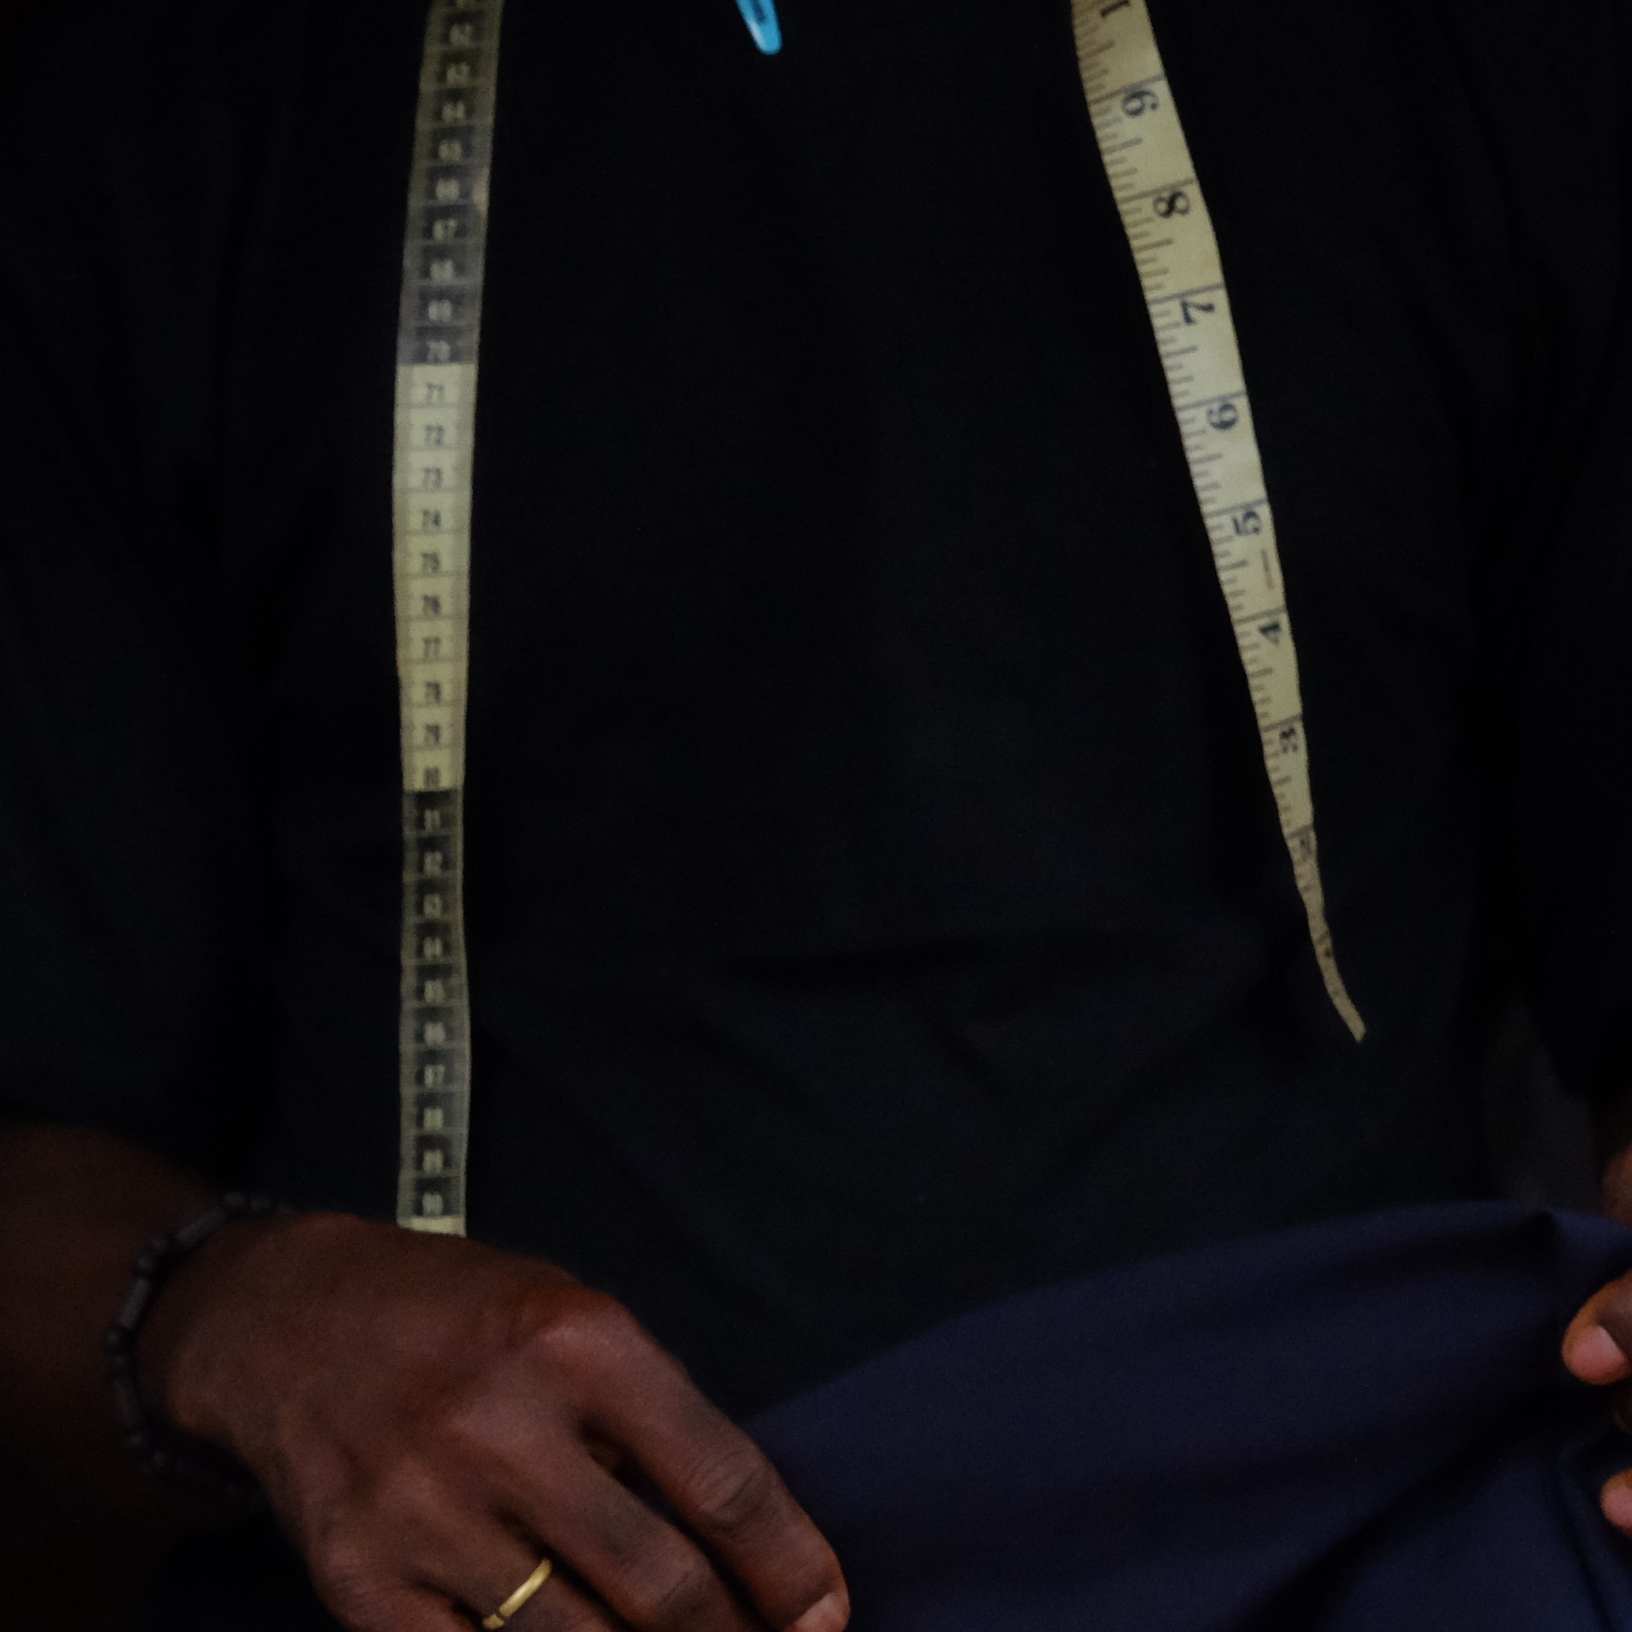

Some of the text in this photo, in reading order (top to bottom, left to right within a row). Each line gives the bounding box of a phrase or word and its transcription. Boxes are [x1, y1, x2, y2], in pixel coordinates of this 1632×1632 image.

[1121, 88, 1159, 118] 9
[1153, 190, 1191, 219] 8
[1181, 300, 1216, 326] 7
[1206, 402, 1240, 431] 6
[1233, 511, 1261, 536] 5
